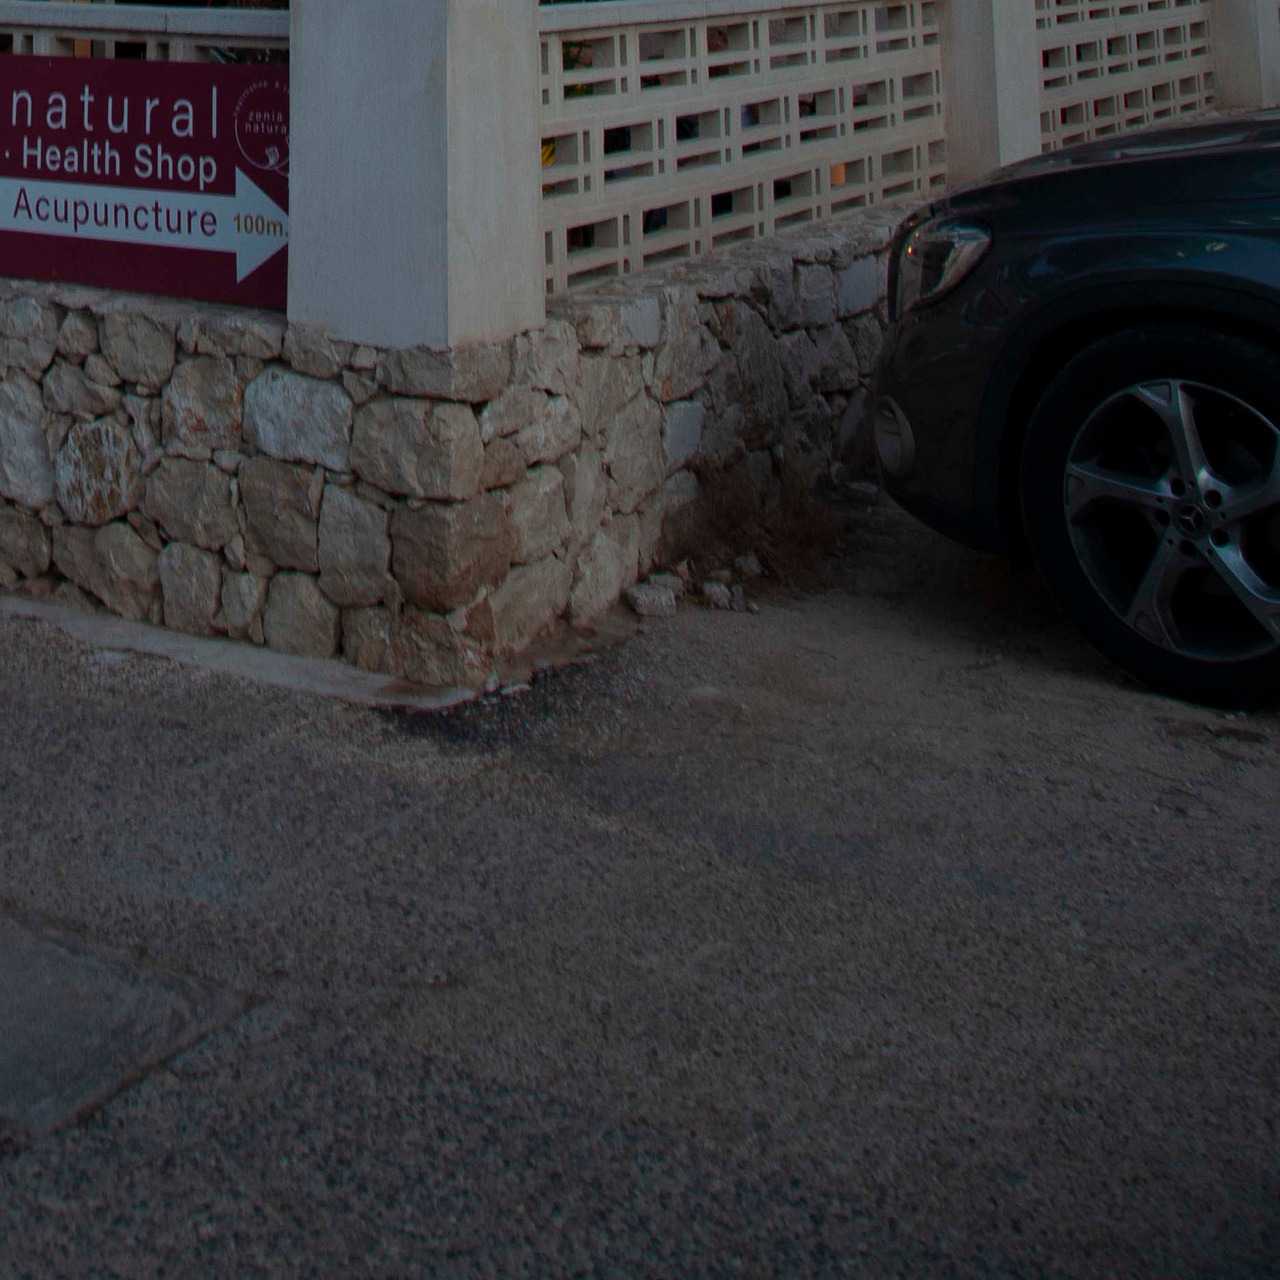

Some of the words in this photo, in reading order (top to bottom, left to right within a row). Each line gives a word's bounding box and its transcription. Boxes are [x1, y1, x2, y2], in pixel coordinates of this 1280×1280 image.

[11, 84, 218, 139] natural
[245, 121, 288, 136] natura
[248, 108, 283, 123] zenia
[22, 135, 121, 176] Health
[134, 142, 217, 192] Shop
[13, 187, 218, 237] Acupuncture
